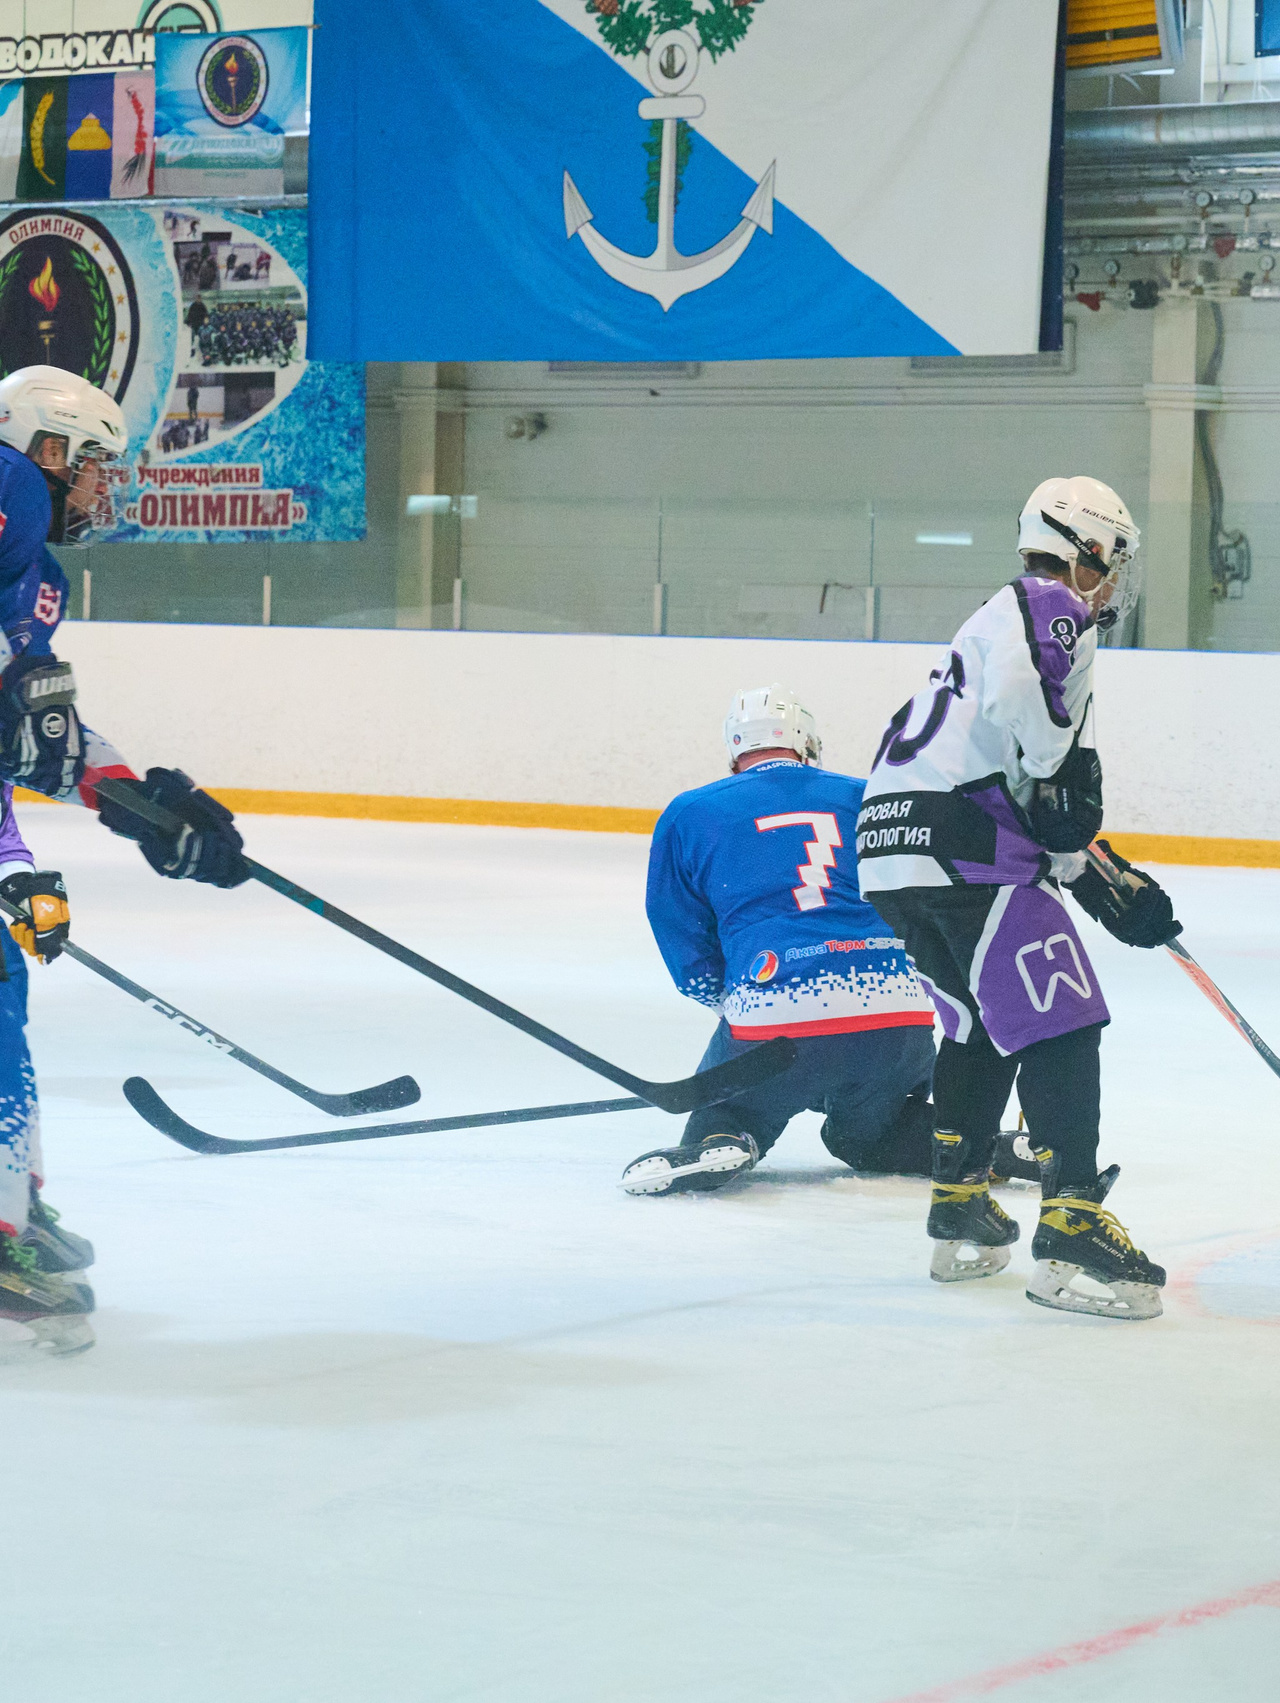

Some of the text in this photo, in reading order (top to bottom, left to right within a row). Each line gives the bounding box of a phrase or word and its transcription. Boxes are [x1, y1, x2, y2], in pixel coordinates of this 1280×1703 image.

[8, 218, 86, 245] ОЛИМПИЯ
[137, 464, 261, 488] Учреждения
[126, 492, 304, 527] «ОЛИМПИЯ»
[754, 811, 843, 912] 7
[1091, 1236, 1126, 1260] BAUER
